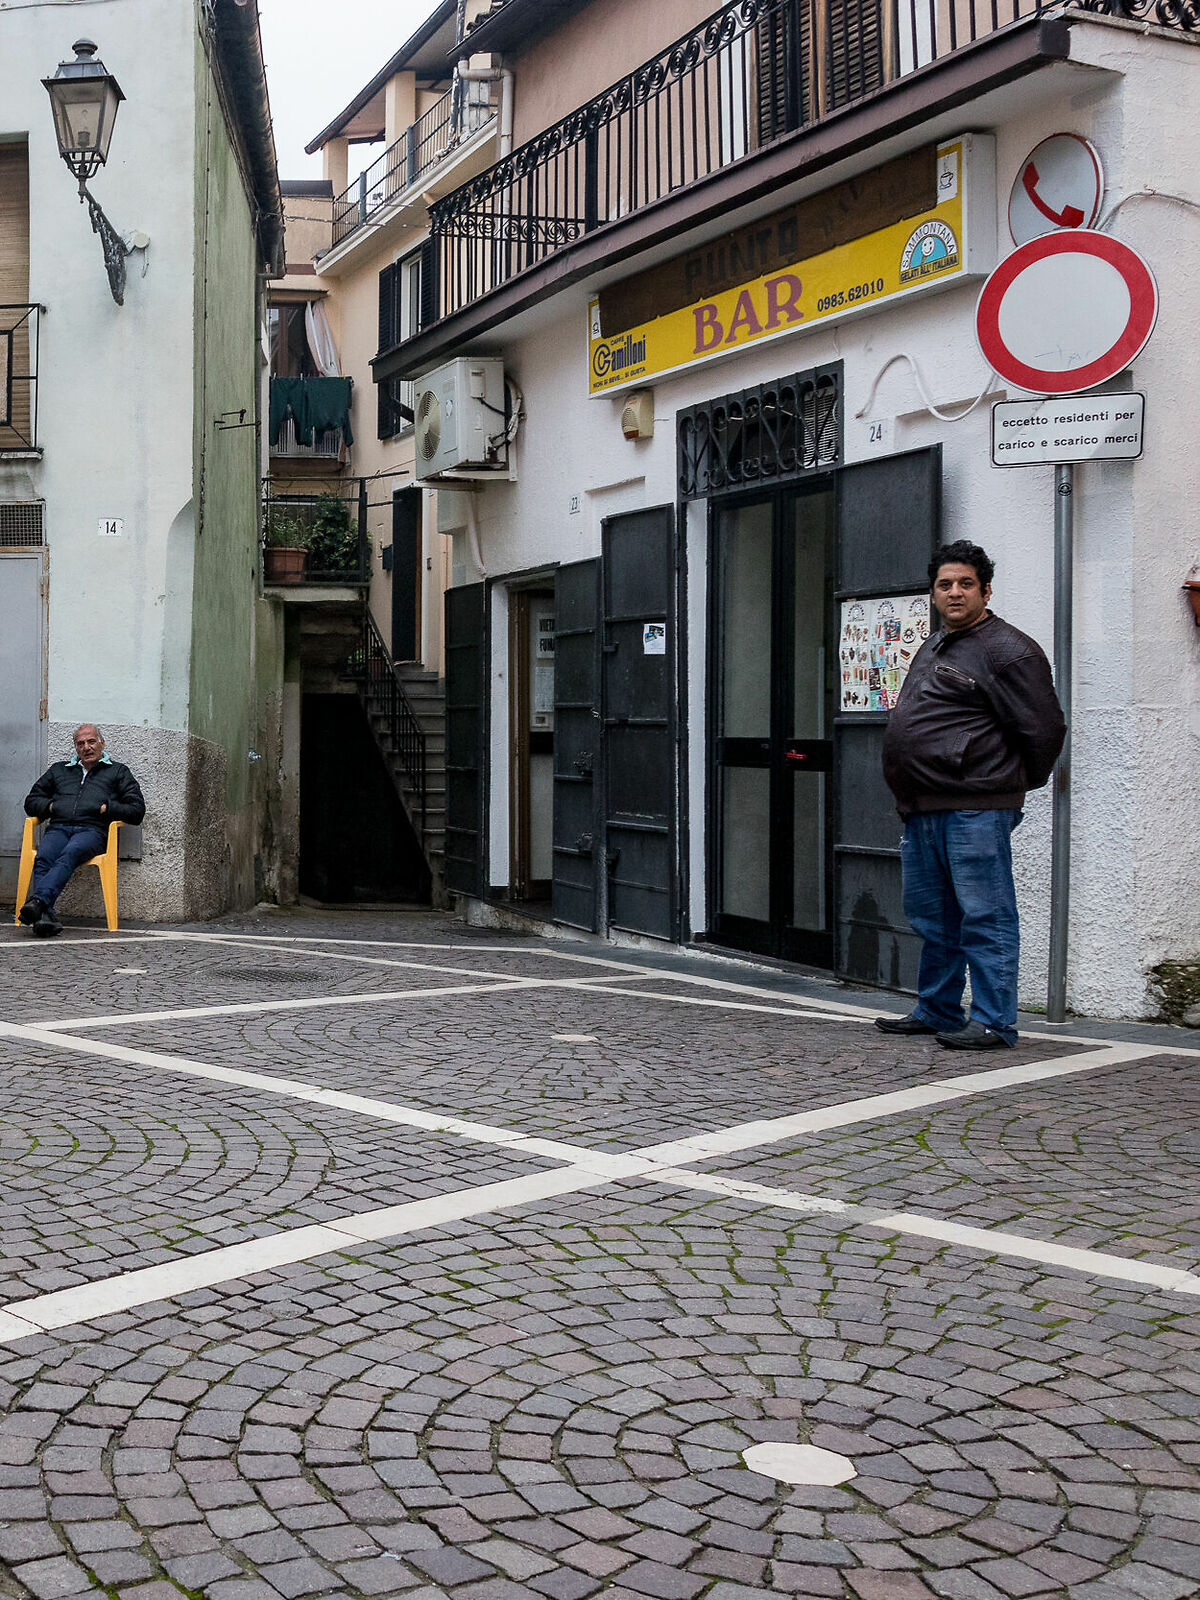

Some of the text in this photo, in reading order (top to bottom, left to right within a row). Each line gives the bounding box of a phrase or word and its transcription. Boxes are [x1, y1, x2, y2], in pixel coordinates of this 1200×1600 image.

[902, 222, 956, 269] SAMMONTANA
[901, 268, 920, 281] GELATI
[932, 255, 957, 270] ITALIANA
[692, 274, 885, 354] BAR 0983.62010
[593, 334, 646, 377] Camilloni
[1002, 411, 1135, 428] eccetto residenti per
[870, 423, 881, 442] 24
[998, 439, 1035, 450] carico
[1054, 435, 1099, 447] scarico
[1104, 433, 1138, 444] merci
[106, 521, 117, 534] 14
